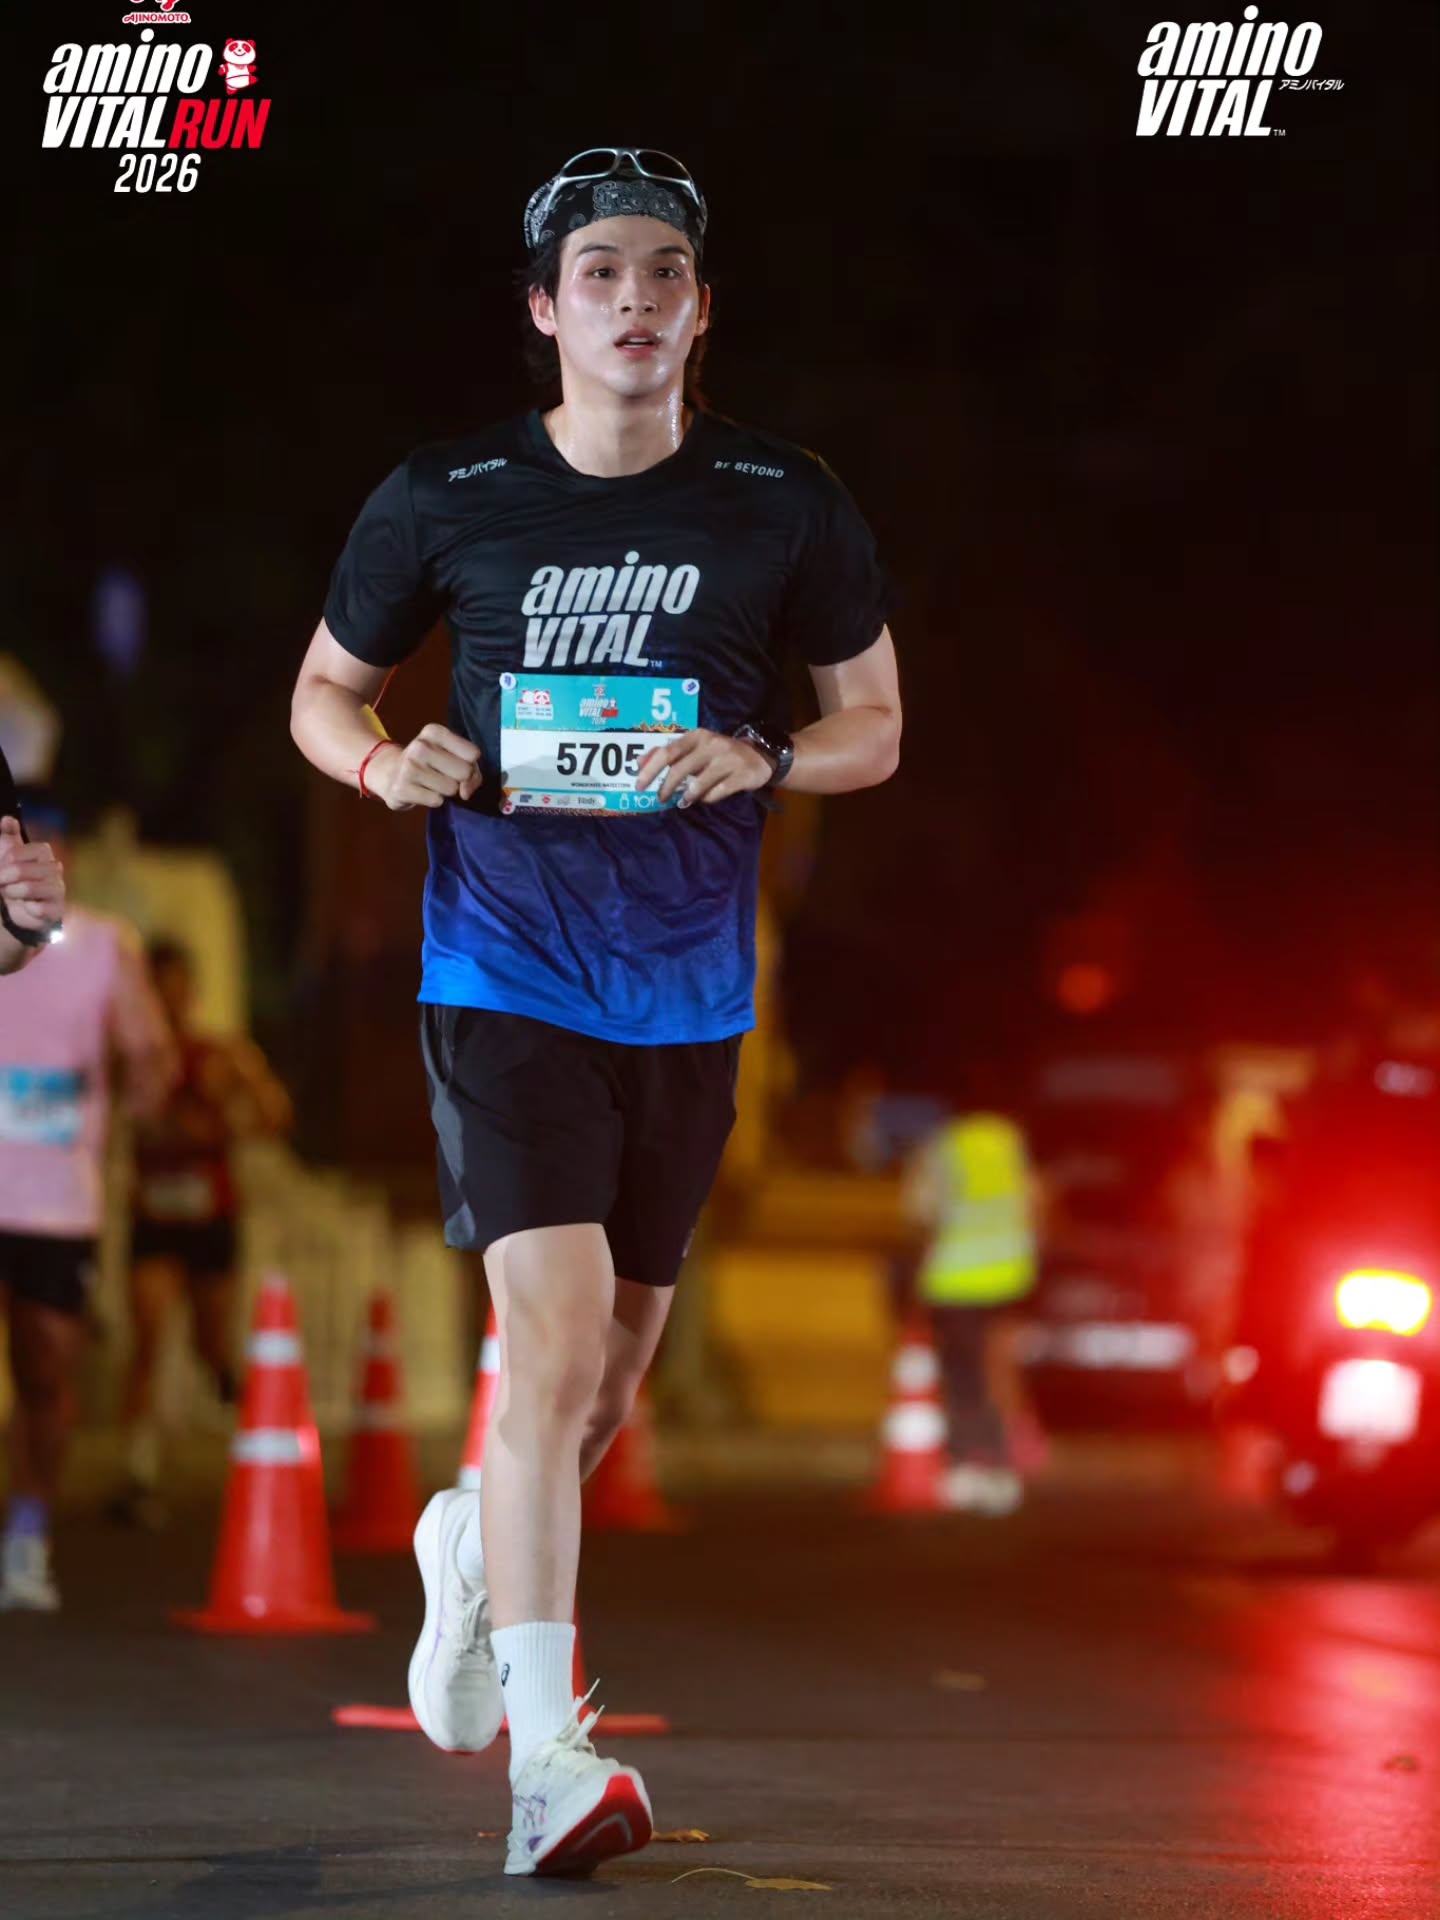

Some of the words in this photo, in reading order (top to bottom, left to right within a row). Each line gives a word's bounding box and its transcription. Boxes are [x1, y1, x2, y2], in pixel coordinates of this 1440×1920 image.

[734, 462, 785, 478] BEYOND
[521, 551, 700, 616] amino
[523, 614, 652, 668] VITAL
[556, 743, 644, 776] 5705
